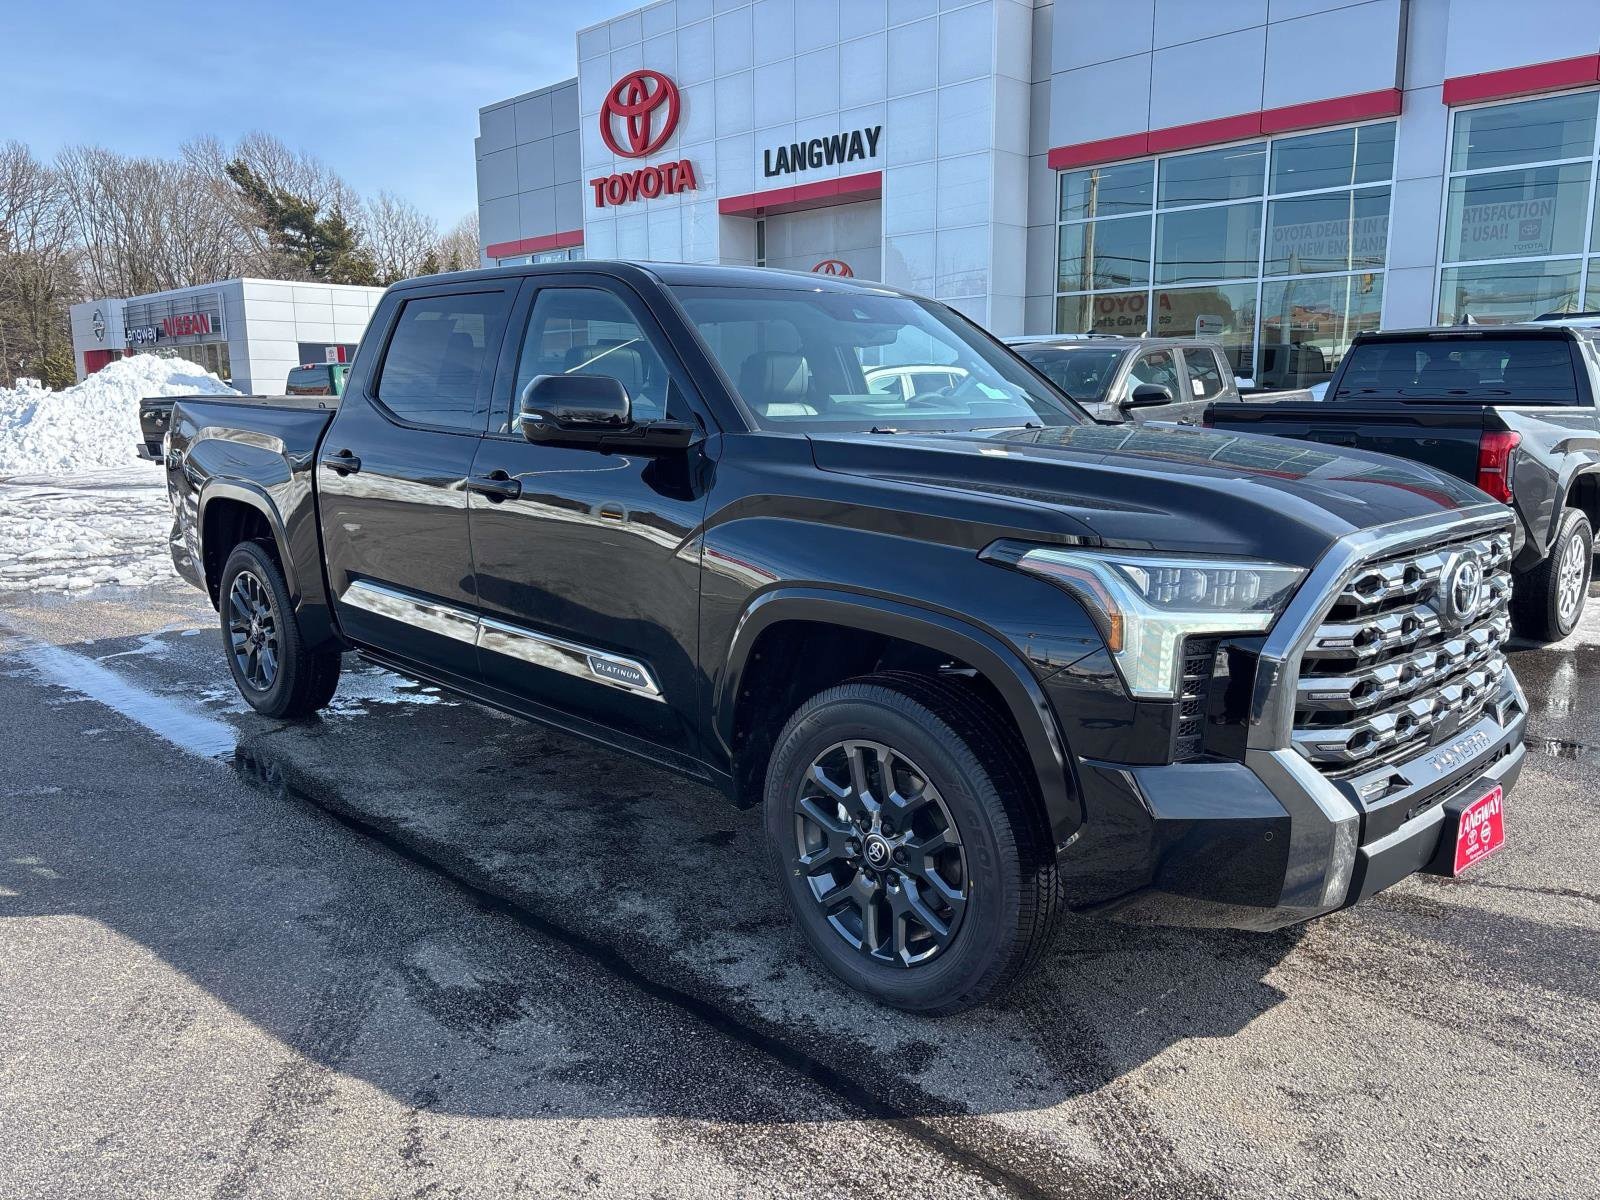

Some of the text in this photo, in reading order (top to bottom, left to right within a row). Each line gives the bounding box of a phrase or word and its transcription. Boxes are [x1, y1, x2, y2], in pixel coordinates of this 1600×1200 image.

[764, 125, 882, 177] LANGWAY
[589, 159, 698, 208] TOYOTA
[1463, 200, 1551, 224] ATISFACTION
[1272, 225, 1313, 242] OYOTA
[1472, 223, 1509, 242] USA!!
[1297, 241, 1324, 257] NEW
[1096, 293, 1171, 313] OYOA
[124, 313, 212, 344] Langway NISSAN
[596, 663, 640, 680] PLATINUM
[1424, 730, 1491, 774] TUNDRA
[1458, 796, 1500, 840] LANGWAY
